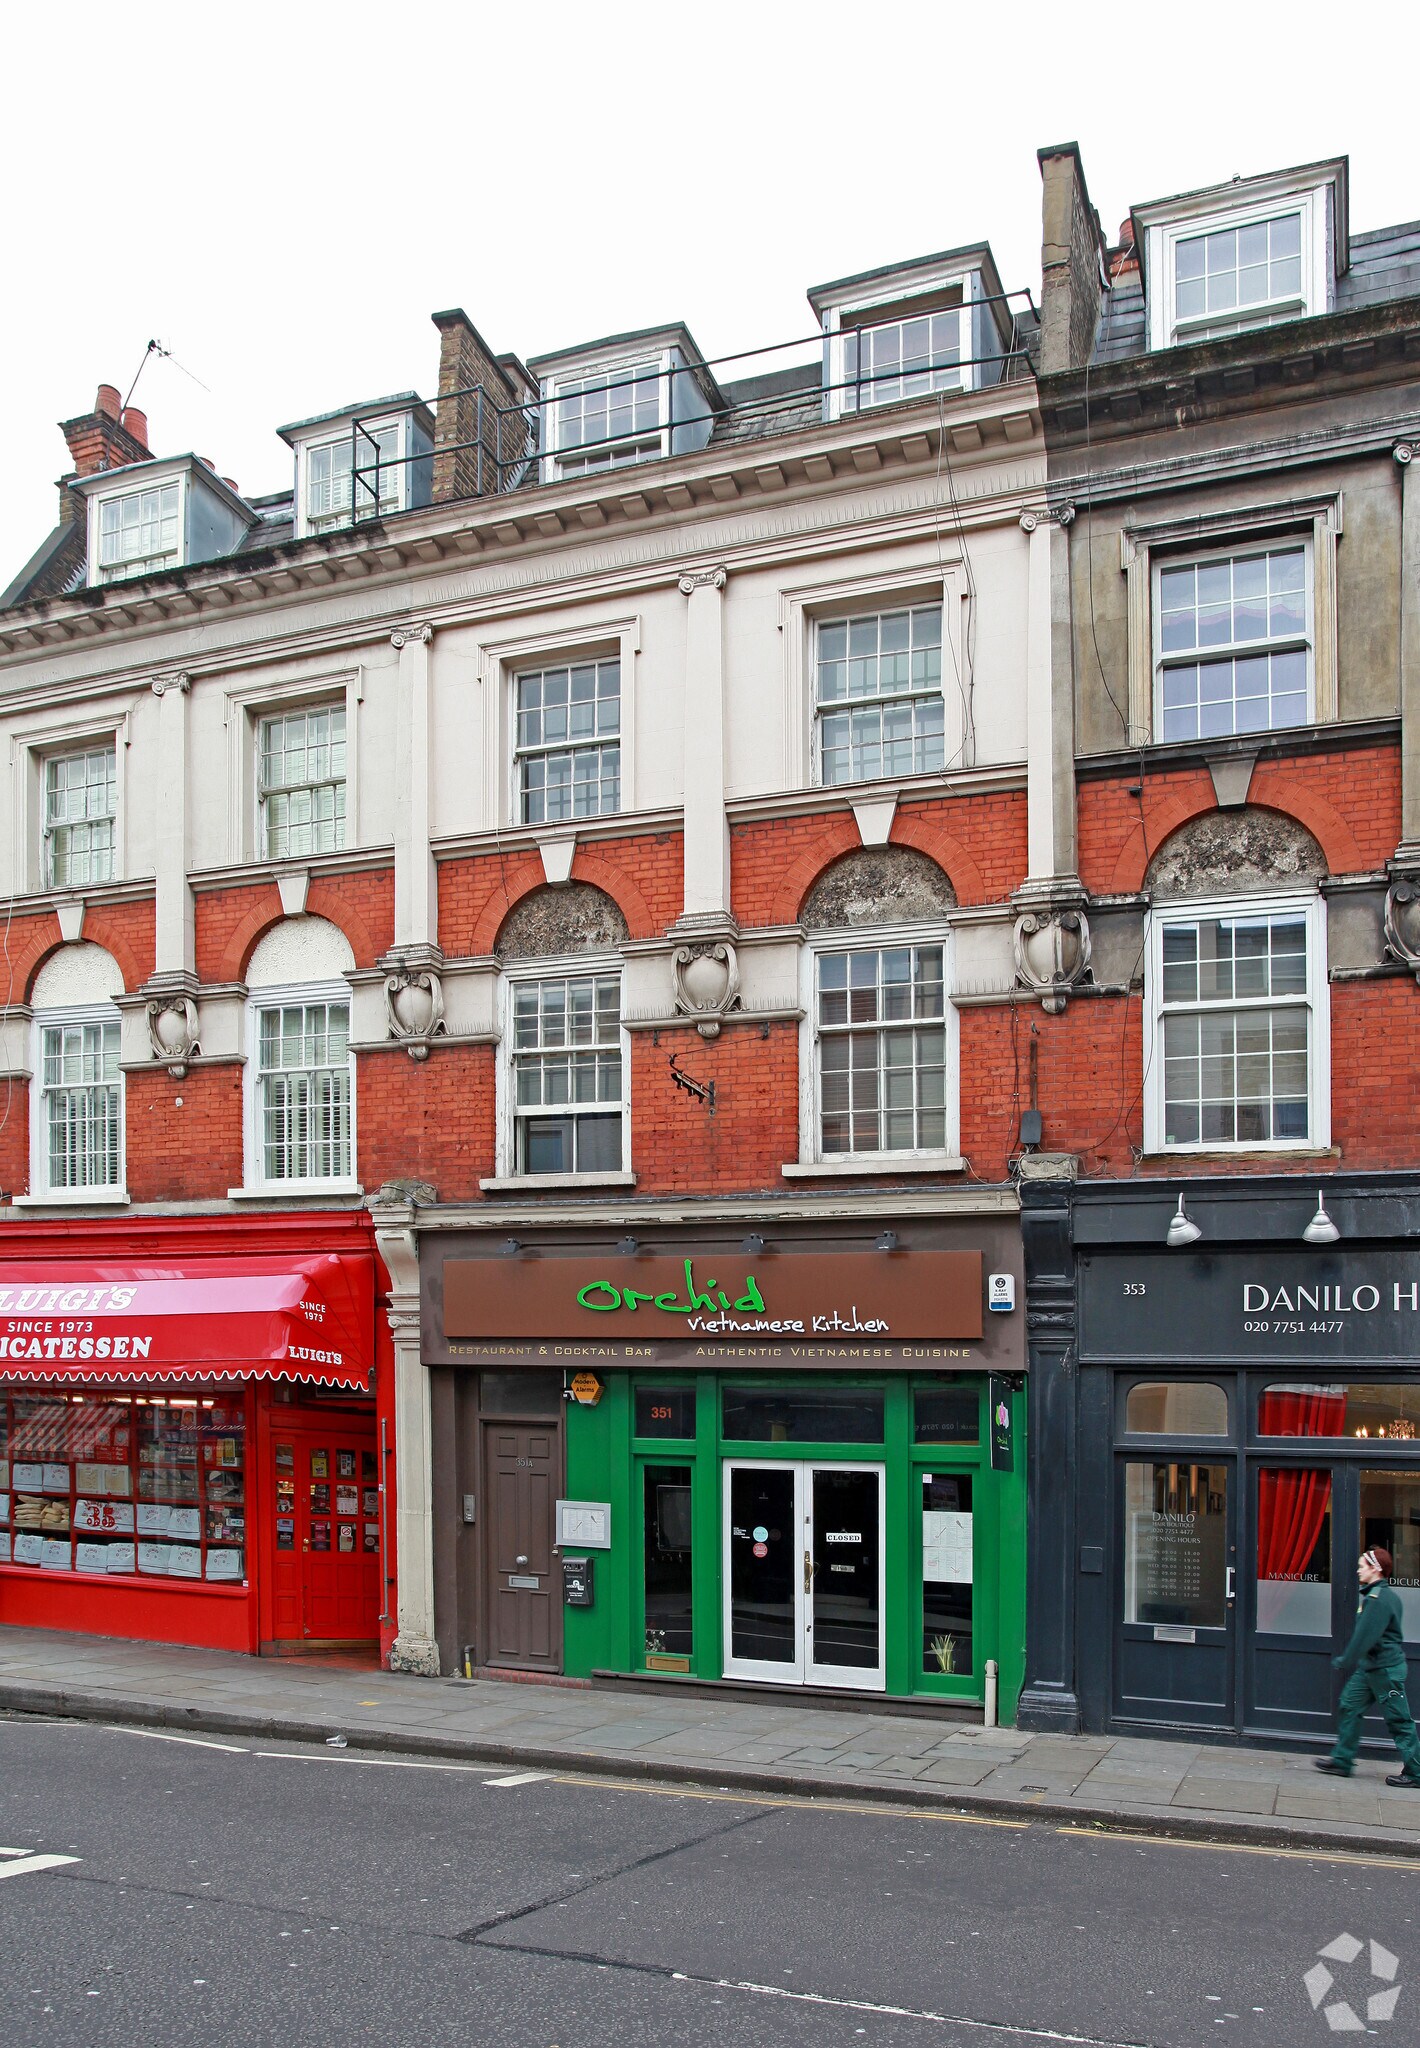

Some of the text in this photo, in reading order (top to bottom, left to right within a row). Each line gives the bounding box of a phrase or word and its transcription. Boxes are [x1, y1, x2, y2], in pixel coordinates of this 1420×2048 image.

[1122, 1283, 1146, 1295] 353
[0, 1286, 138, 1311] LUIGI'S
[1243, 1284, 1380, 1312] DANILO
[299, 1300, 326, 1313] SINCE
[304, 1311, 323, 1322] 1973
[7, 1321, 93, 1333] SINCE 1973
[1244, 1321, 1343, 1333] 020 7751 4477
[0, 1336, 153, 1359] ICATESSEN
[449, 1345, 652, 1356] RESTAURANT & COCKTAIL BAR
[696, 1347, 971, 1357] AUTHENTIC VIETNAMESE CUISINE
[288, 1345, 343, 1365] LUIGI'S
[651, 1407, 672, 1418] 351
[1152, 1512, 1195, 1523] DANILO
[1268, 1572, 1319, 1582] MANICURE
[1389, 1577, 1420, 1587] DICUR
